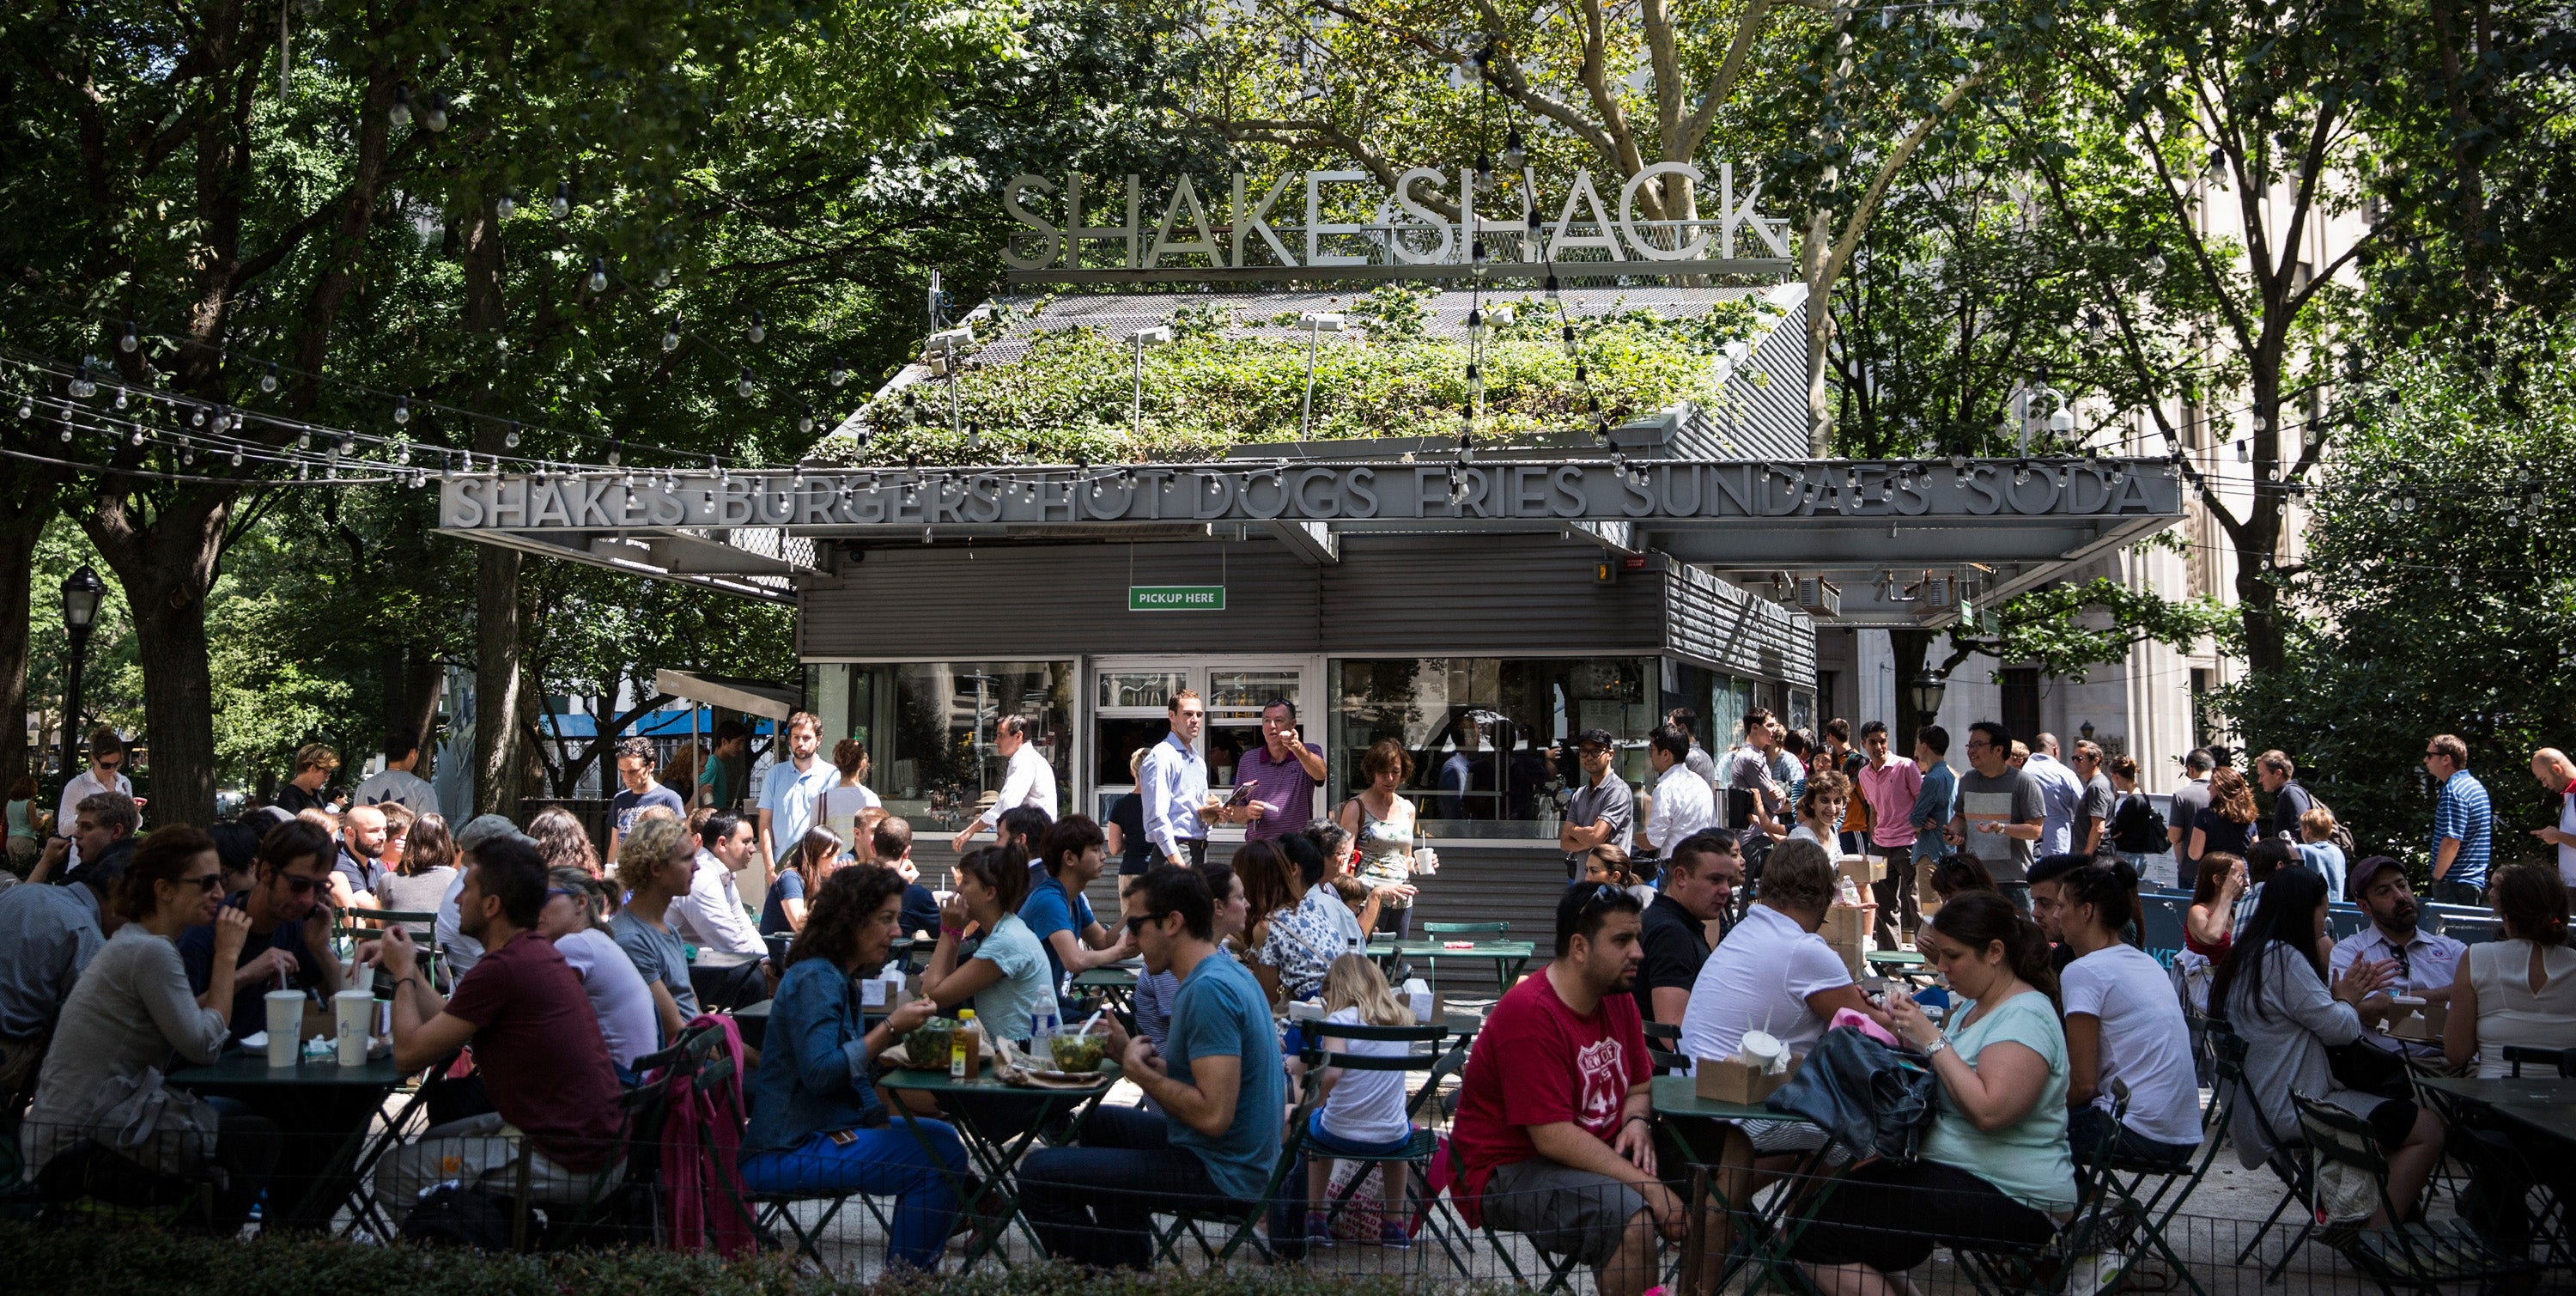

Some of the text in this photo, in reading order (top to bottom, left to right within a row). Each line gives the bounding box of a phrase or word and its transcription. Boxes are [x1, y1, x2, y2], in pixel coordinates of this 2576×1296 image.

[998, 161, 1792, 269] SHAKE SHACK
[452, 461, 2157, 527] SHAKES BURGERS HOT DOGS FRIES SUNDAES SODA
[1139, 593, 1214, 603] PICKUP HERE
